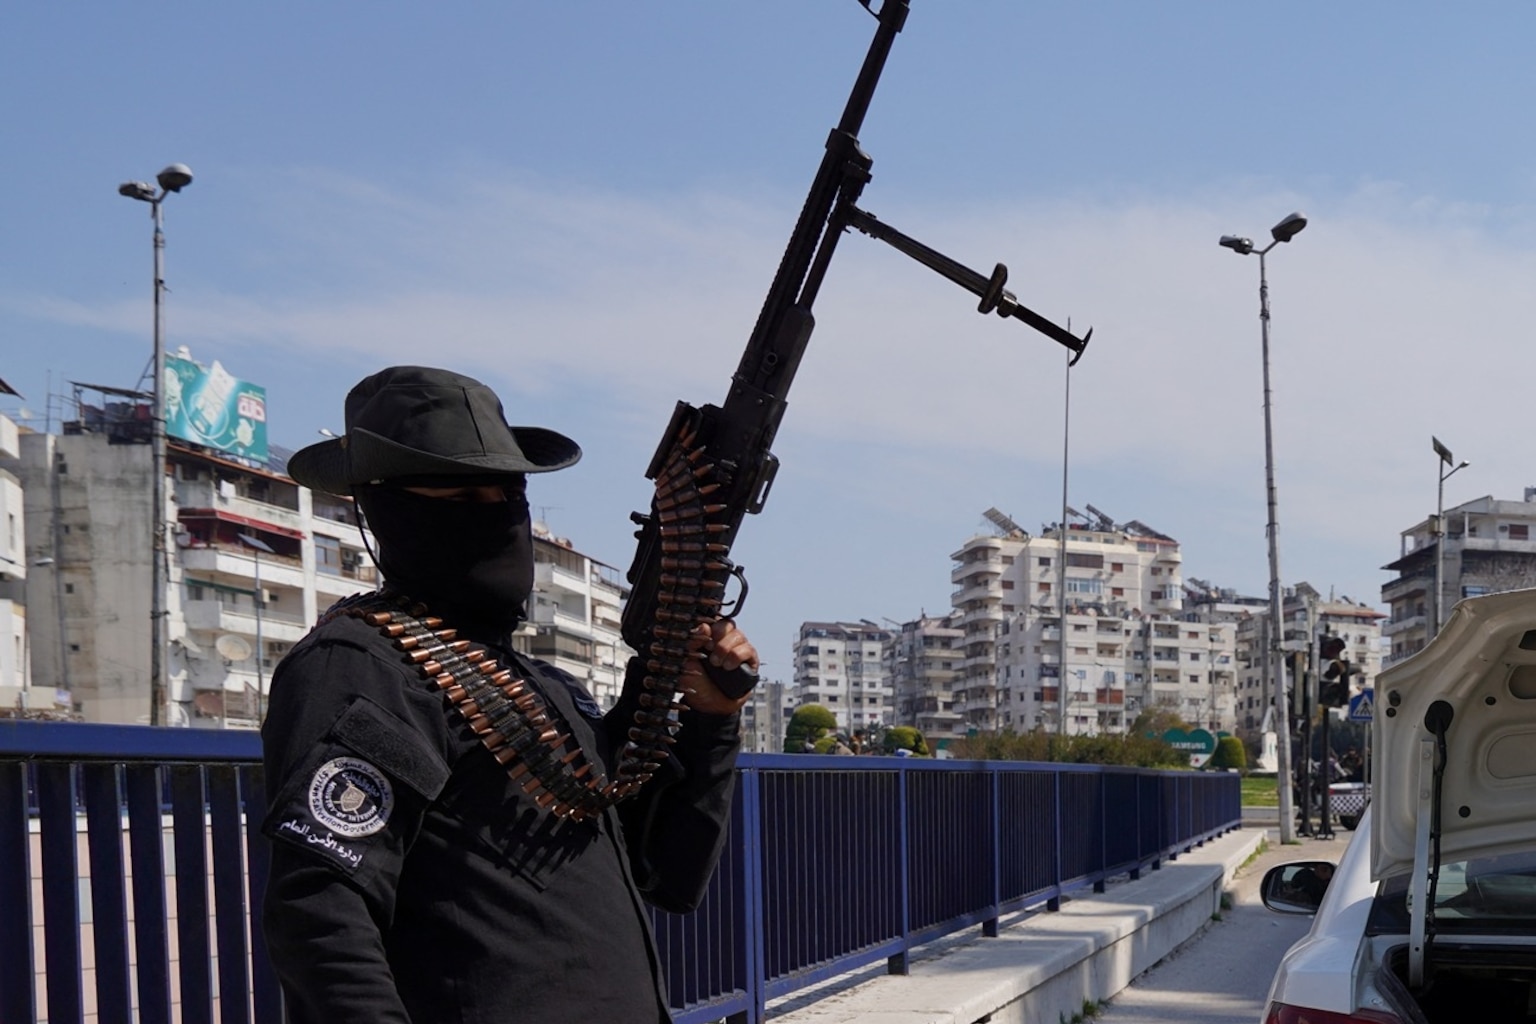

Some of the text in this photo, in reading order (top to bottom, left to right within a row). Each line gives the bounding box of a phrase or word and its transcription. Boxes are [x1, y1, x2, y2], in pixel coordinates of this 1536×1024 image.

[280, 819, 363, 867] إدارة الأمن العام
